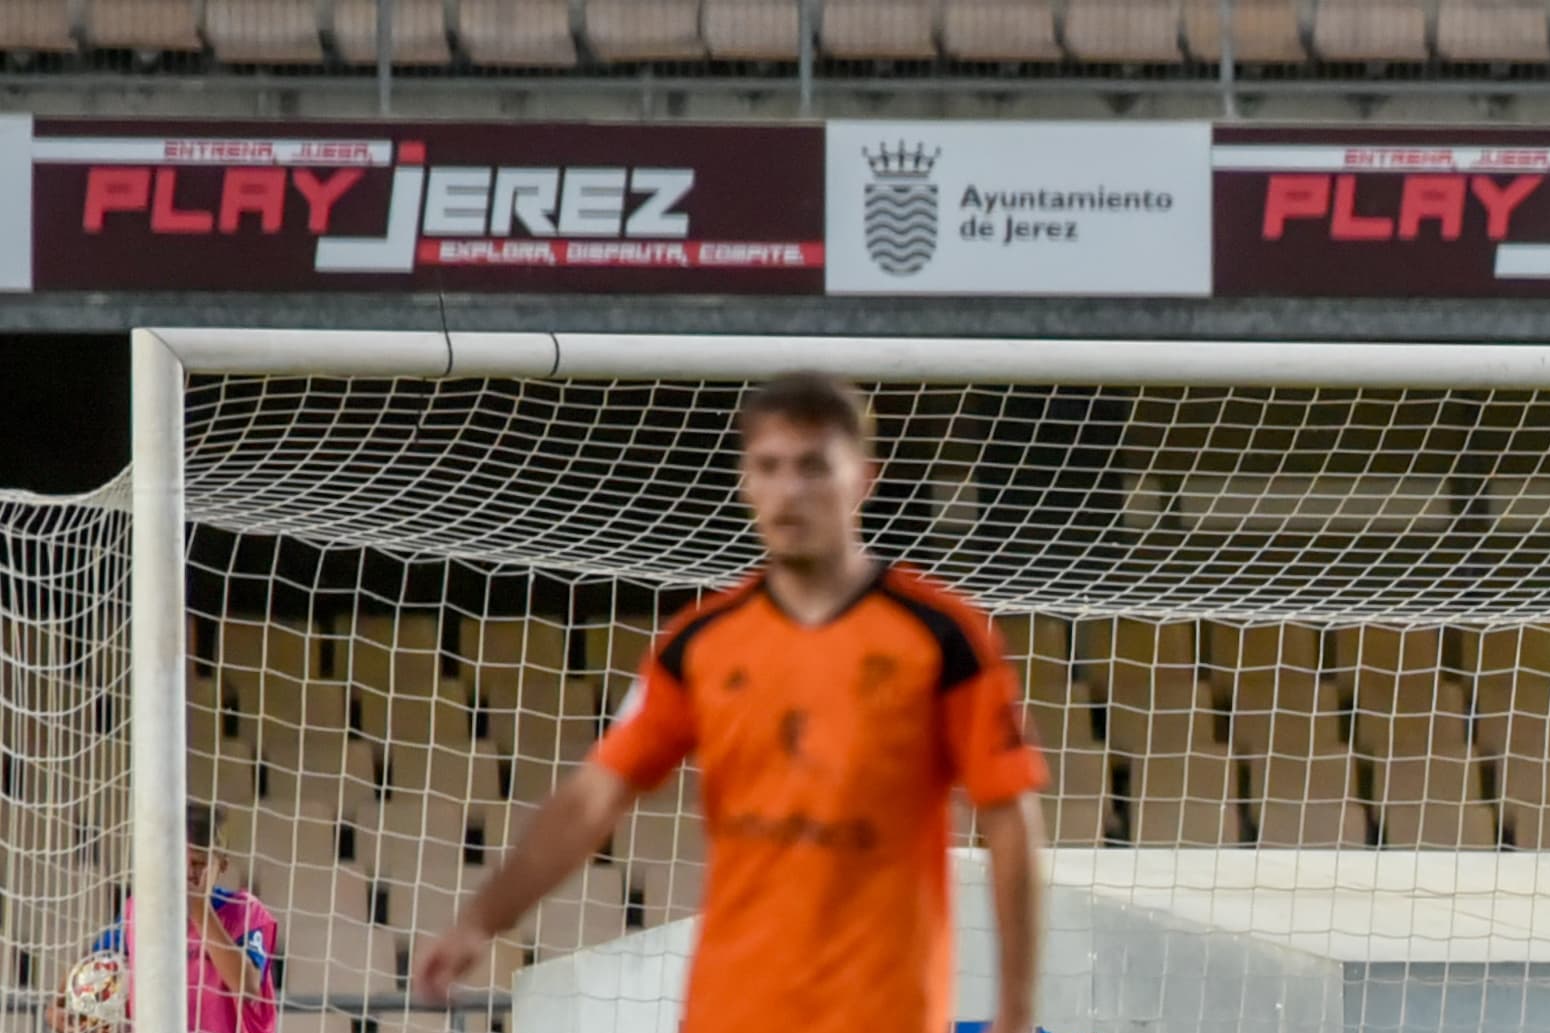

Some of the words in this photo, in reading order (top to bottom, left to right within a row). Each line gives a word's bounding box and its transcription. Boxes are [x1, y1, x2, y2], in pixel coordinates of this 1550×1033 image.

[83, 168, 365, 233] PLAY
[960, 184, 1174, 214] Ayuntamiento
[1262, 174, 1543, 240] PLAY
[959, 214, 995, 240] de
[1003, 215, 1079, 246] Jerez
